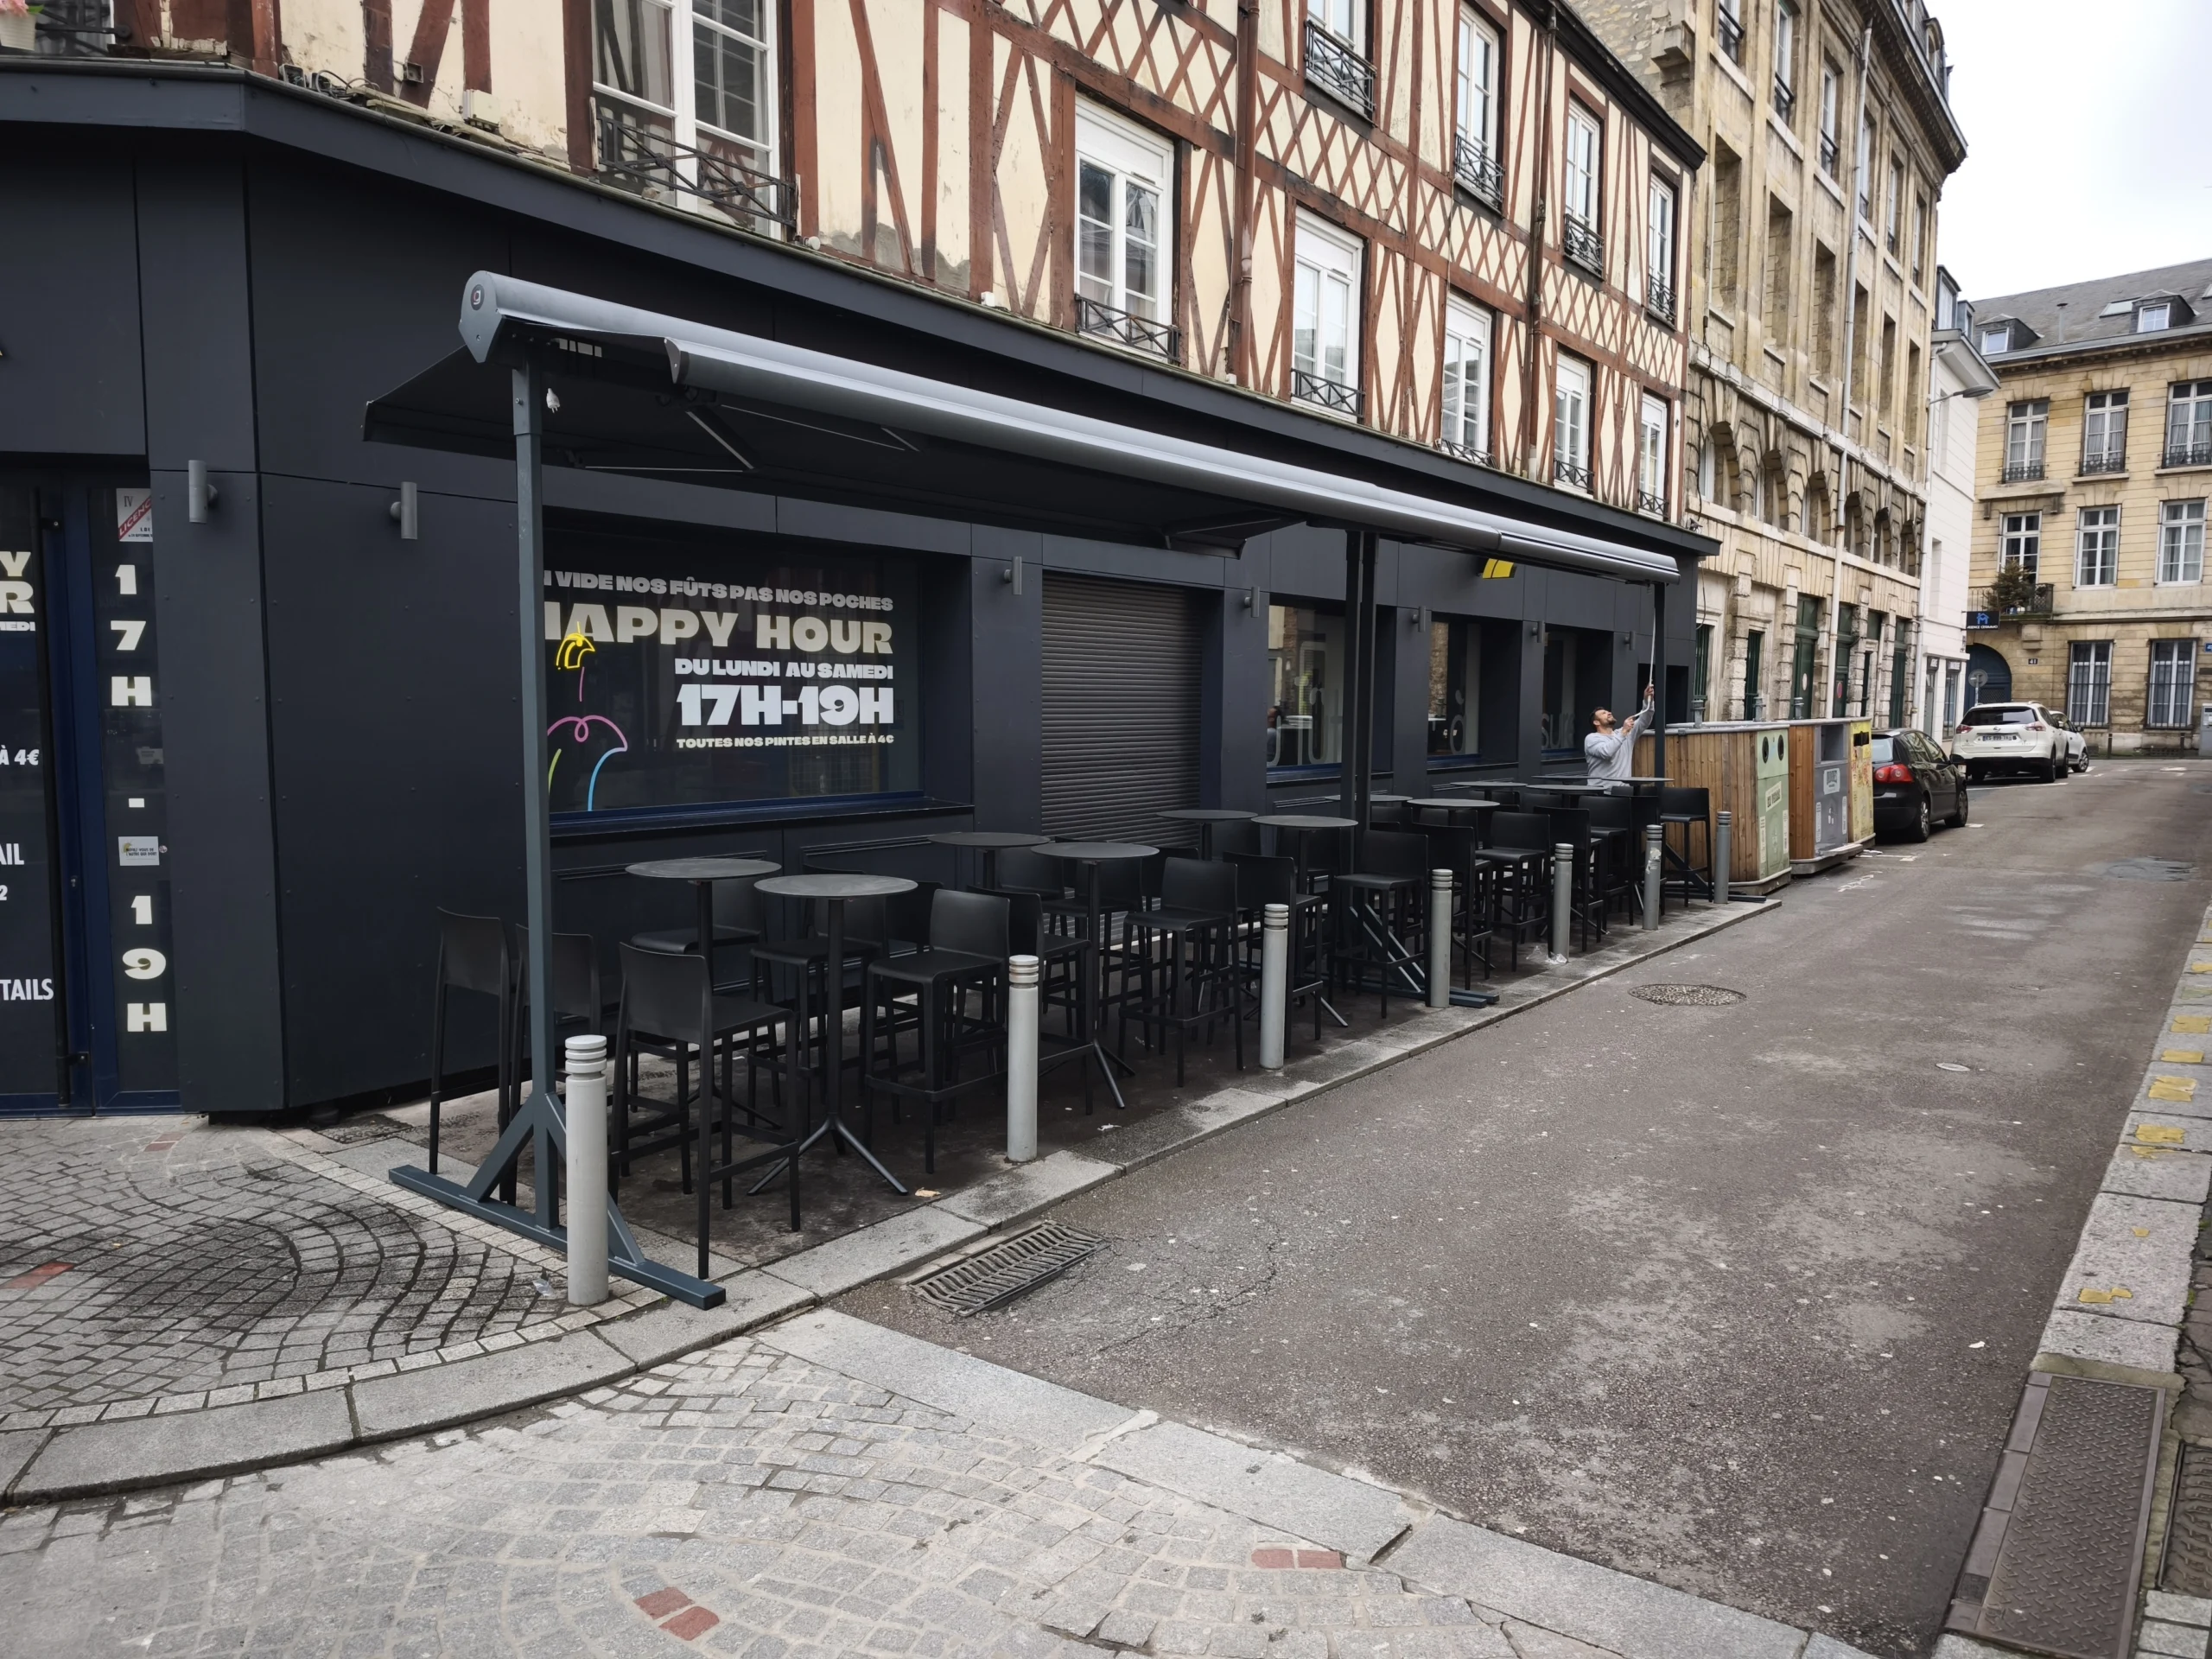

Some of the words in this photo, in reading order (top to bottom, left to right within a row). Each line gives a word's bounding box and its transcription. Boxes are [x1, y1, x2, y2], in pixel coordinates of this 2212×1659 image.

[124, 496, 133, 507] IV
[555, 571, 613, 590] VIDE
[617, 576, 667, 594] NOS
[670, 576, 728, 598] FÛTS
[730, 585, 773, 601] PAS
[776, 589, 817, 605] NOS
[819, 593, 893, 611] POCHES
[756, 614, 893, 653] HOUR
[675, 658, 709, 675] DU
[712, 659, 780, 677] LUNDI
[785, 662, 815, 678] AU
[817, 663, 893, 679] SAMEDI
[676, 683, 894, 726] 17H-19H
[677, 738, 733, 748] TOUTES
[734, 737, 763, 747] NOS
[765, 736, 810, 747] PINTES
[812, 735, 828, 745] EN
[829, 735, 867, 745] SALLE
[868, 733, 876, 743] À
[14, 749, 40, 766] 4€
